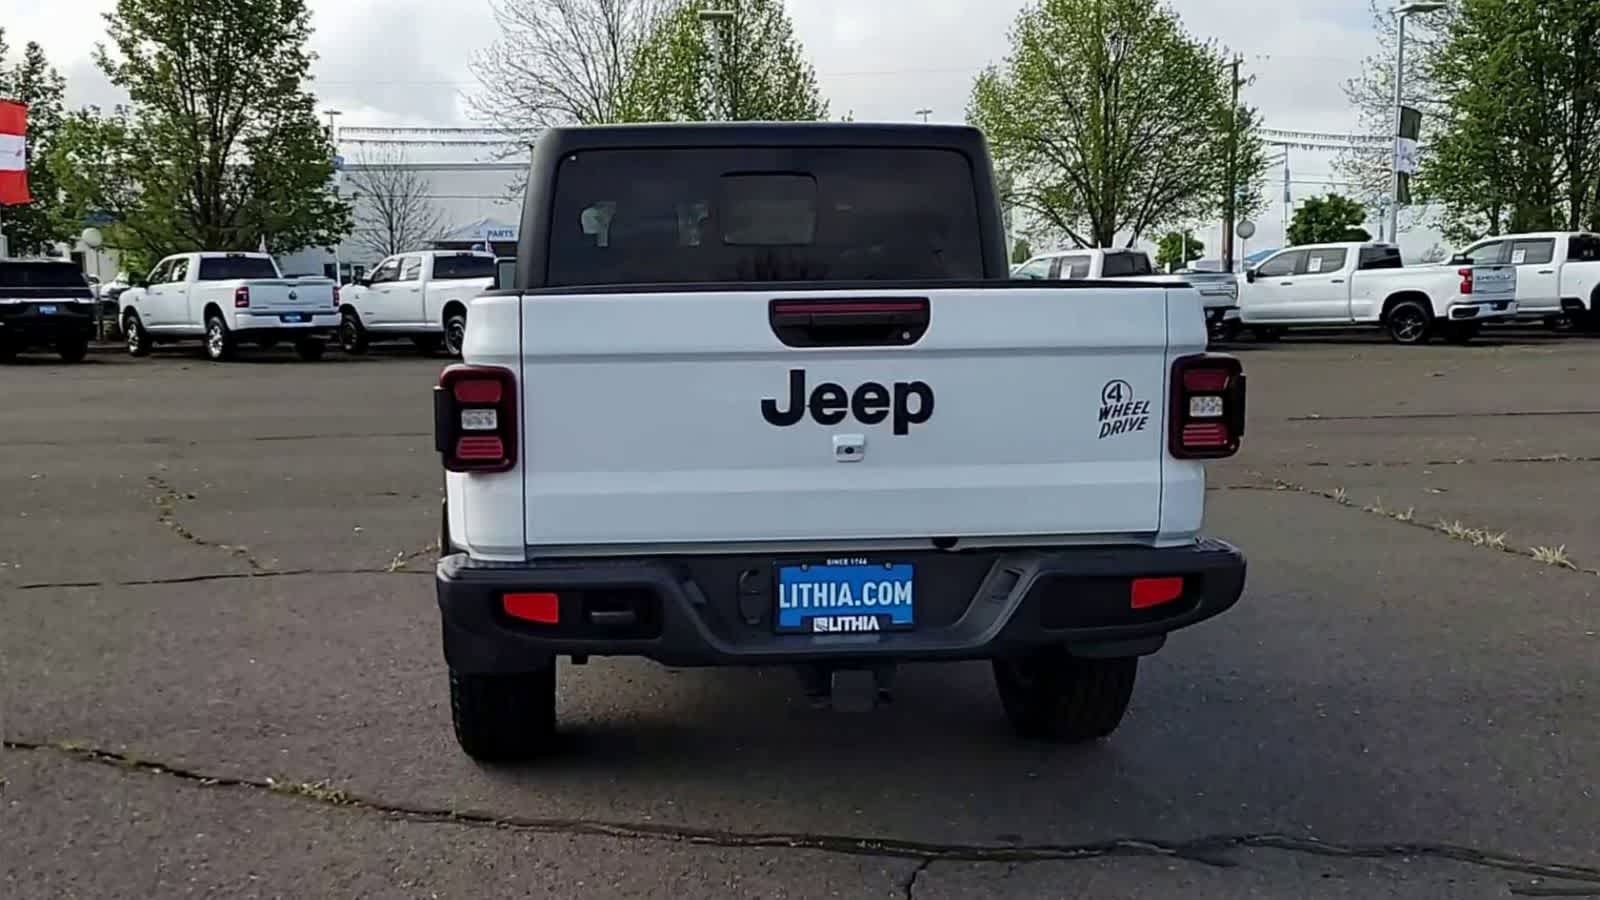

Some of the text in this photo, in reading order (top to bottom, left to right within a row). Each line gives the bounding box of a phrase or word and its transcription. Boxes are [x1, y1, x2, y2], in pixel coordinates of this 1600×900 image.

[761, 369, 935, 435] Jeep
[1107, 383, 1122, 403] 4
[1098, 400, 1150, 422] WHEEL
[1098, 416, 1149, 439] DRIVE
[826, 558, 848, 566] SINCE
[779, 580, 913, 609] LITHIA.COM
[828, 615, 880, 632] LITHIA
